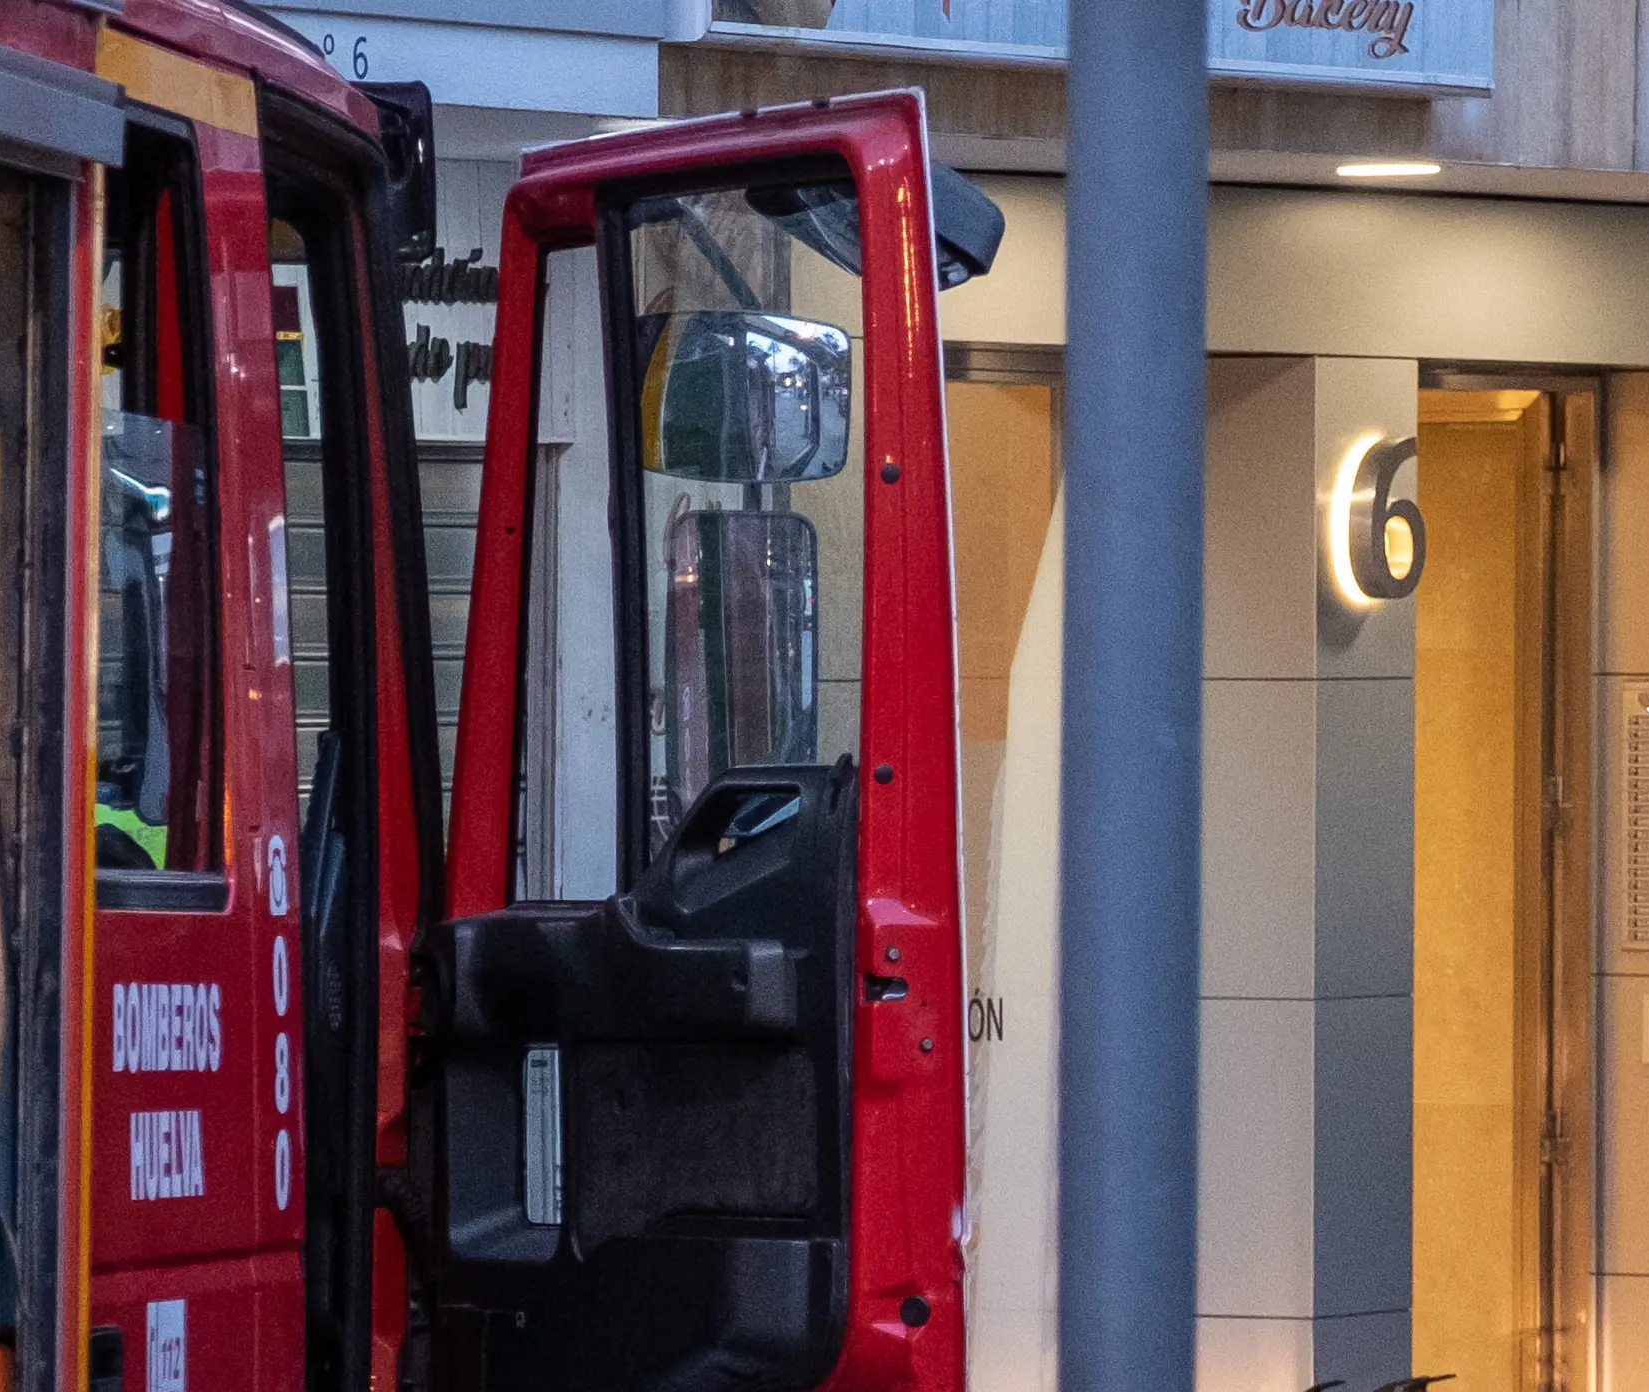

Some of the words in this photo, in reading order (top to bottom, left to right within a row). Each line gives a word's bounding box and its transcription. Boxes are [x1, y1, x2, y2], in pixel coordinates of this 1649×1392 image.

[1349, 436, 1426, 600] 6
[112, 981, 222, 1074] BOMBEROS
[130, 1110, 205, 1201] HUELVA
